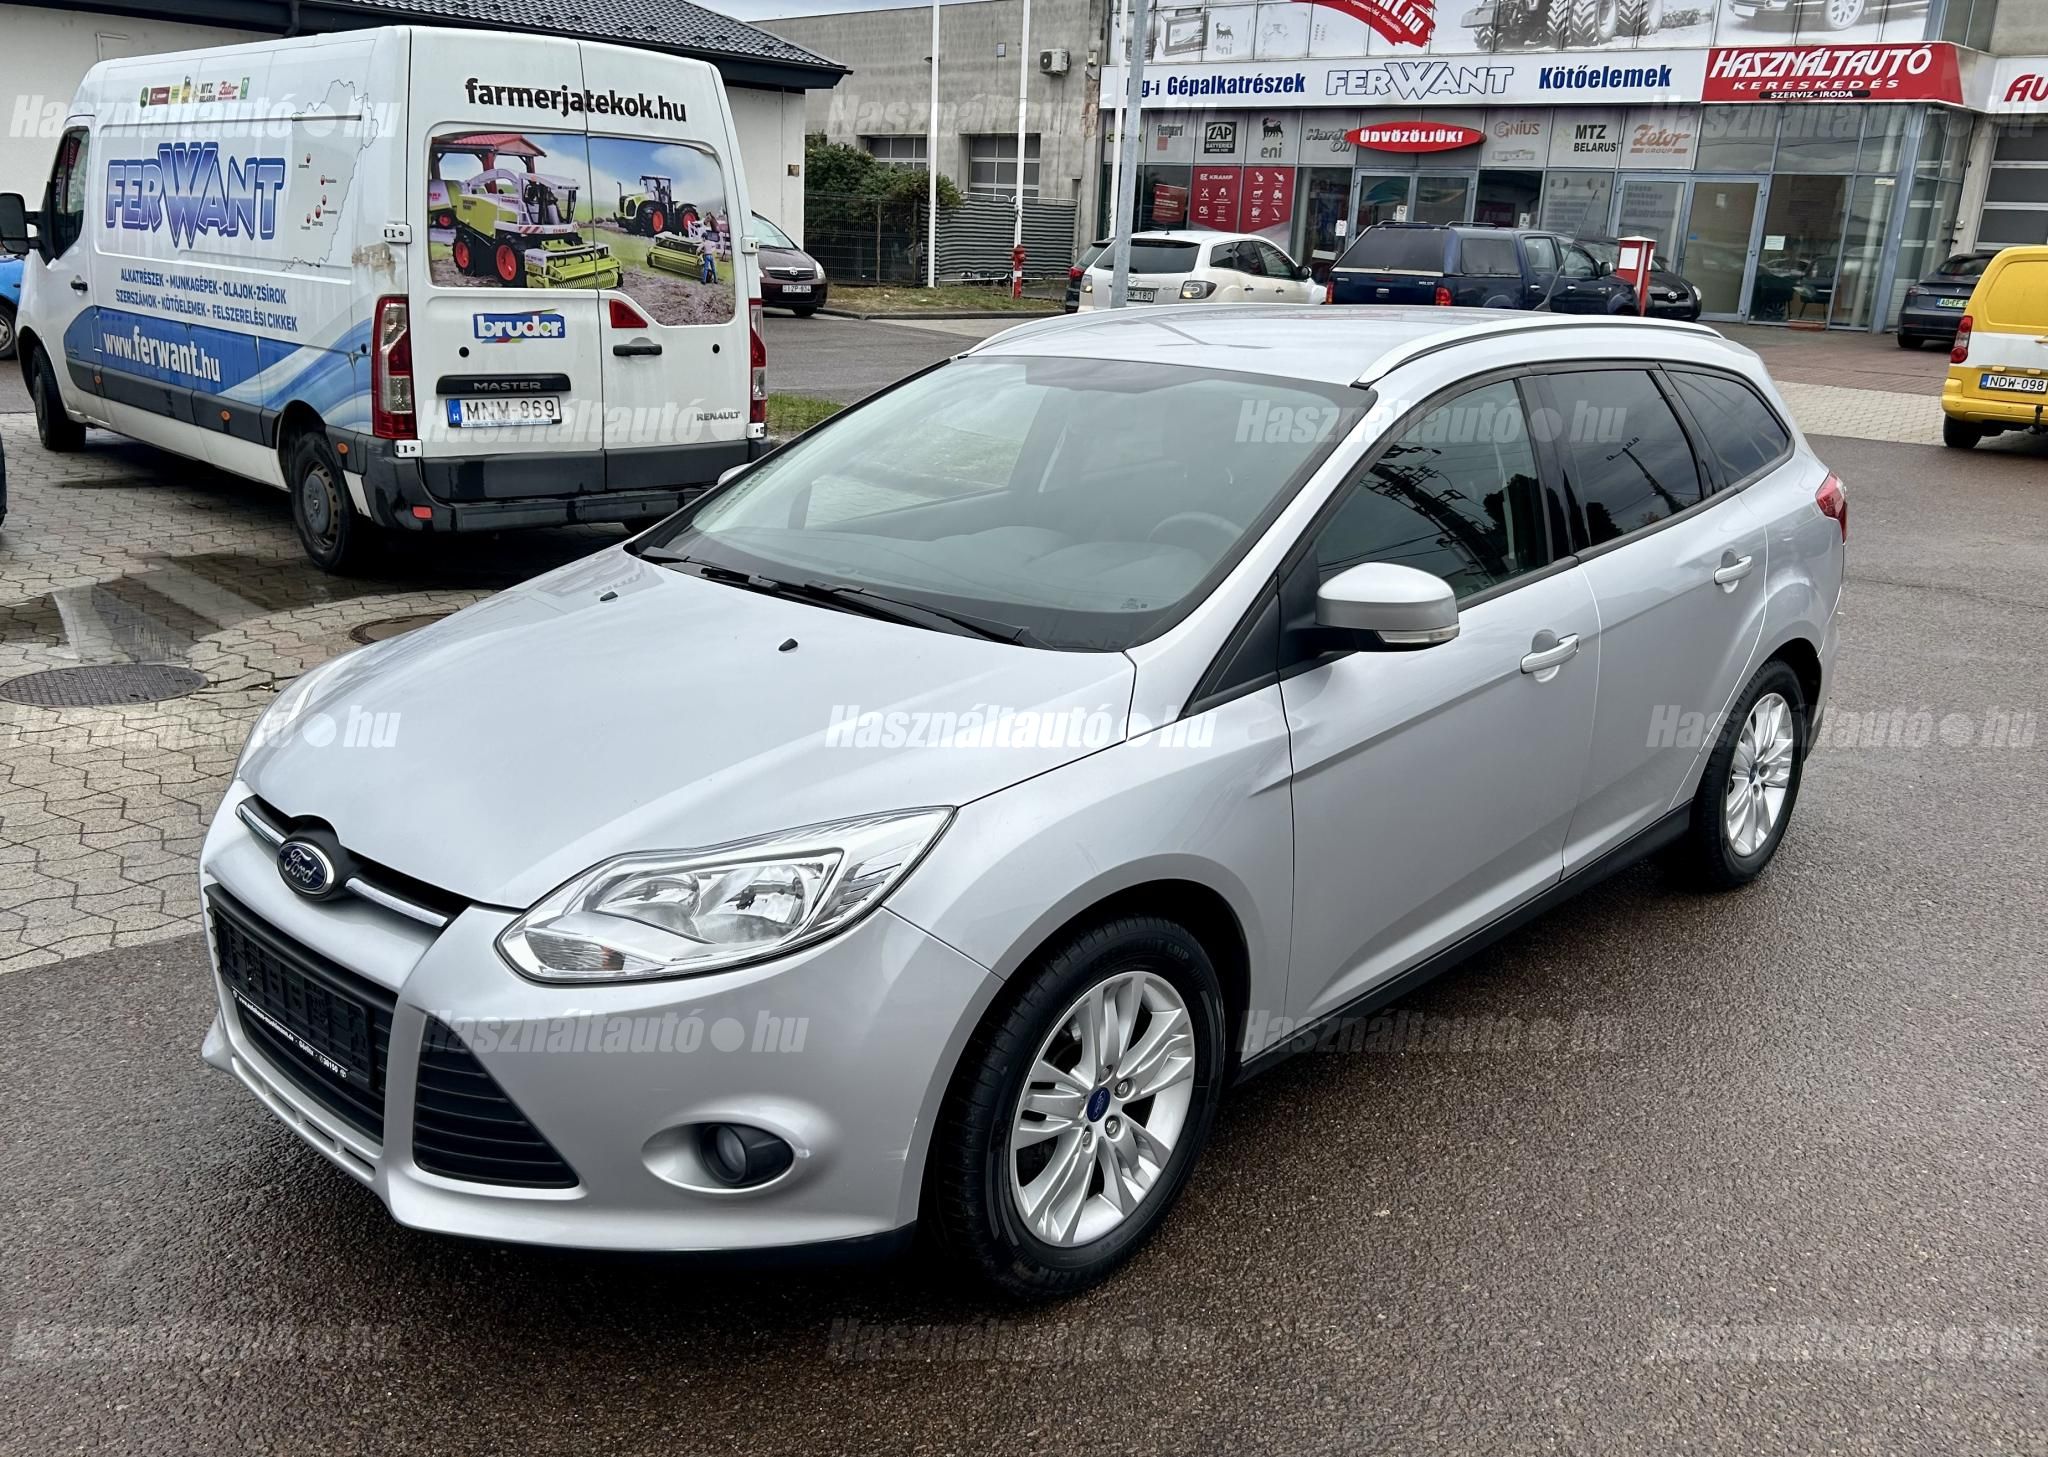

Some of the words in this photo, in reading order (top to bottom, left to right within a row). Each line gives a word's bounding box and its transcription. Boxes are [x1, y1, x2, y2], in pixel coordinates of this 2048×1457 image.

[1373, 0, 1425, 35] nt.hu
[1709, 45, 1933, 79] HASZNÁLTAUTÓ
[1167, 73, 1306, 97] Gépalkatrészek
[1325, 61, 1514, 100] FERWANT
[1538, 64, 1672, 89] Kötőelemek
[1733, 78, 1900, 90] KERESKEDÉS
[465, 78, 687, 122] farmerjatekok.hu
[1208, 126, 1232, 140] ZAP
[1306, 128, 1348, 140] Hard
[1575, 124, 1607, 139] MTZ
[1633, 124, 1690, 147] Zetor
[1260, 141, 1283, 159] eni
[1574, 142, 1617, 153] BELARUS
[105, 141, 286, 249] FERWANT
[121, 268, 164, 287] ALKATRÉSZEK
[169, 275, 218, 295] MUNKAGÉPEK
[115, 289, 157, 308] SZERSZÁMOK
[212, 304, 267, 327] FELSZERELÉSI
[267, 315, 298, 332] CIKKEK
[477, 315, 561, 337] bruder
[103, 325, 221, 383] www.ferwant.hu
[473, 382, 541, 391] MASTER
[1989, 377, 2045, 390] NDW-098
[696, 411, 740, 421] RENAULT
[284, 848, 317, 883] Ford
